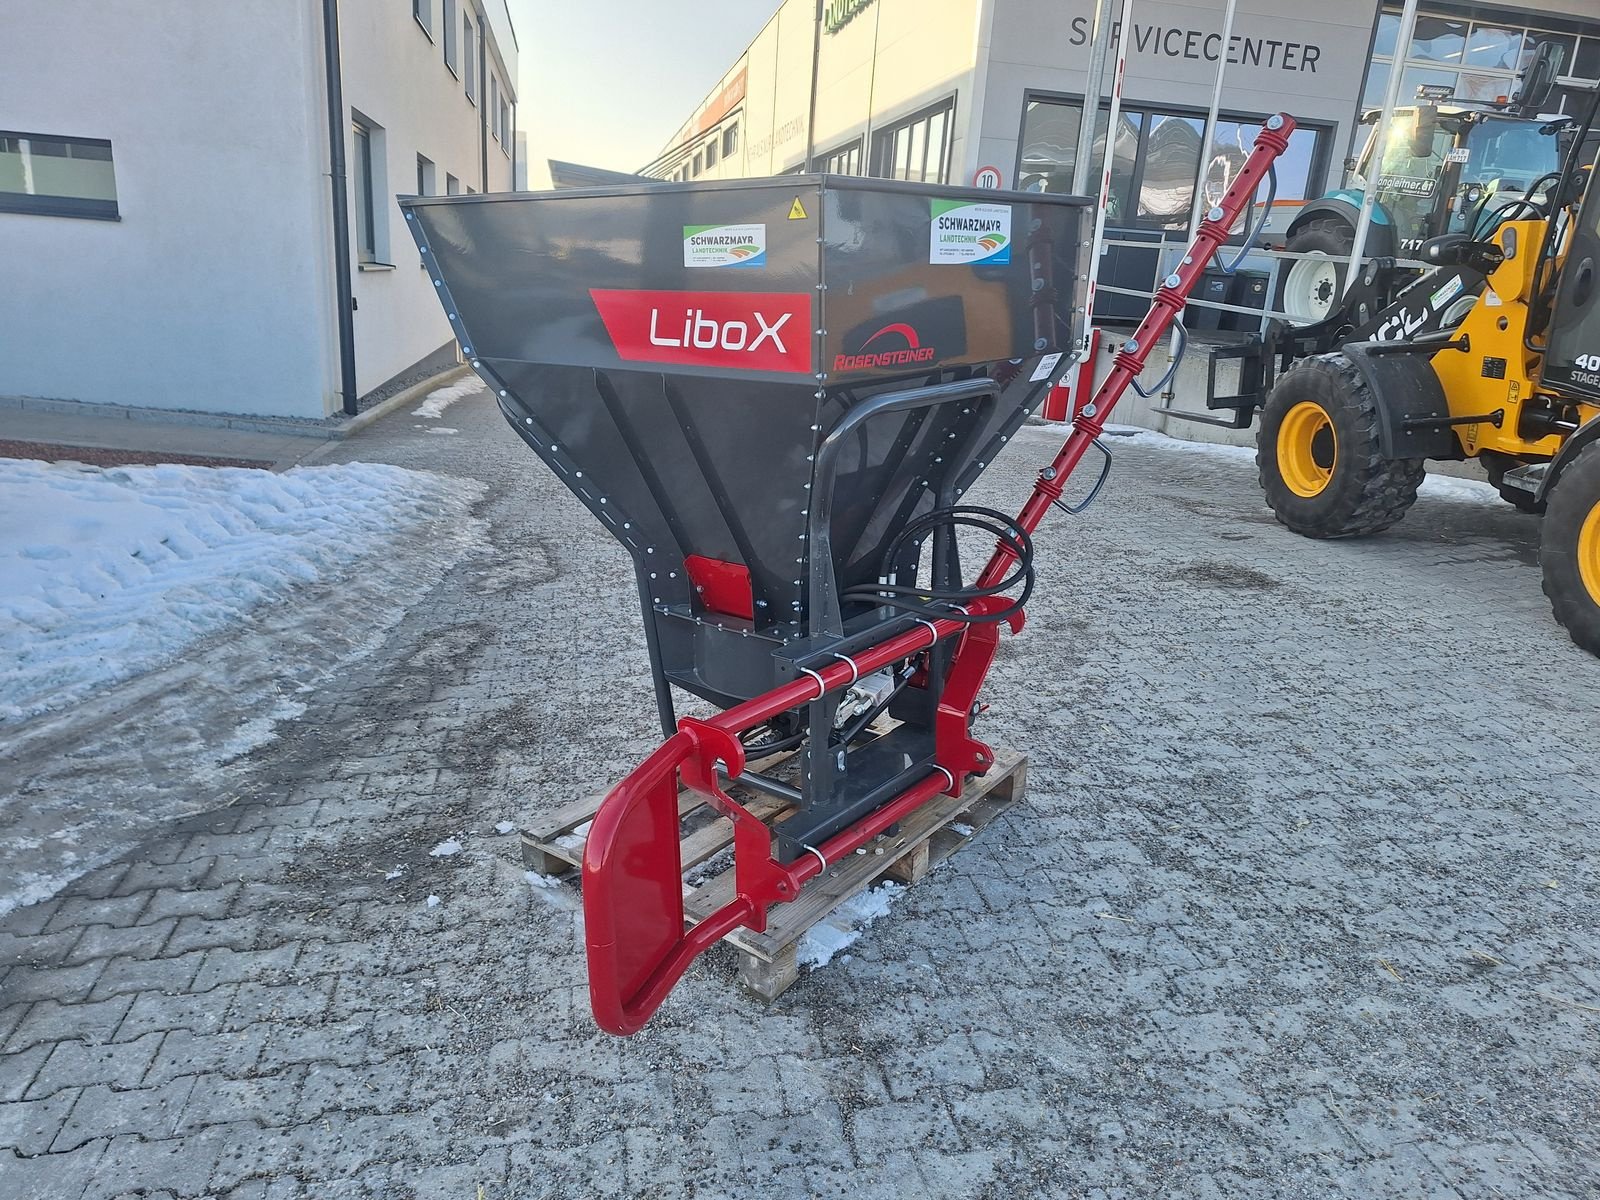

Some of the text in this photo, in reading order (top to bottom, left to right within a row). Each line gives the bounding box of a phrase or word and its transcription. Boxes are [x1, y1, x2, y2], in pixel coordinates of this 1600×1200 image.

[982, 174, 993, 189] 10
[938, 216, 1001, 232] SCHWARZMAYR
[690, 235, 754, 246] SCHWARZMAYR
[939, 234, 977, 244] LANDTECHNIK
[1400, 239, 1423, 251] 717
[649, 308, 792, 354] LiboX
[832, 347, 935, 372] ROSENSTEINER
[1570, 370, 1600, 386] STAGE
